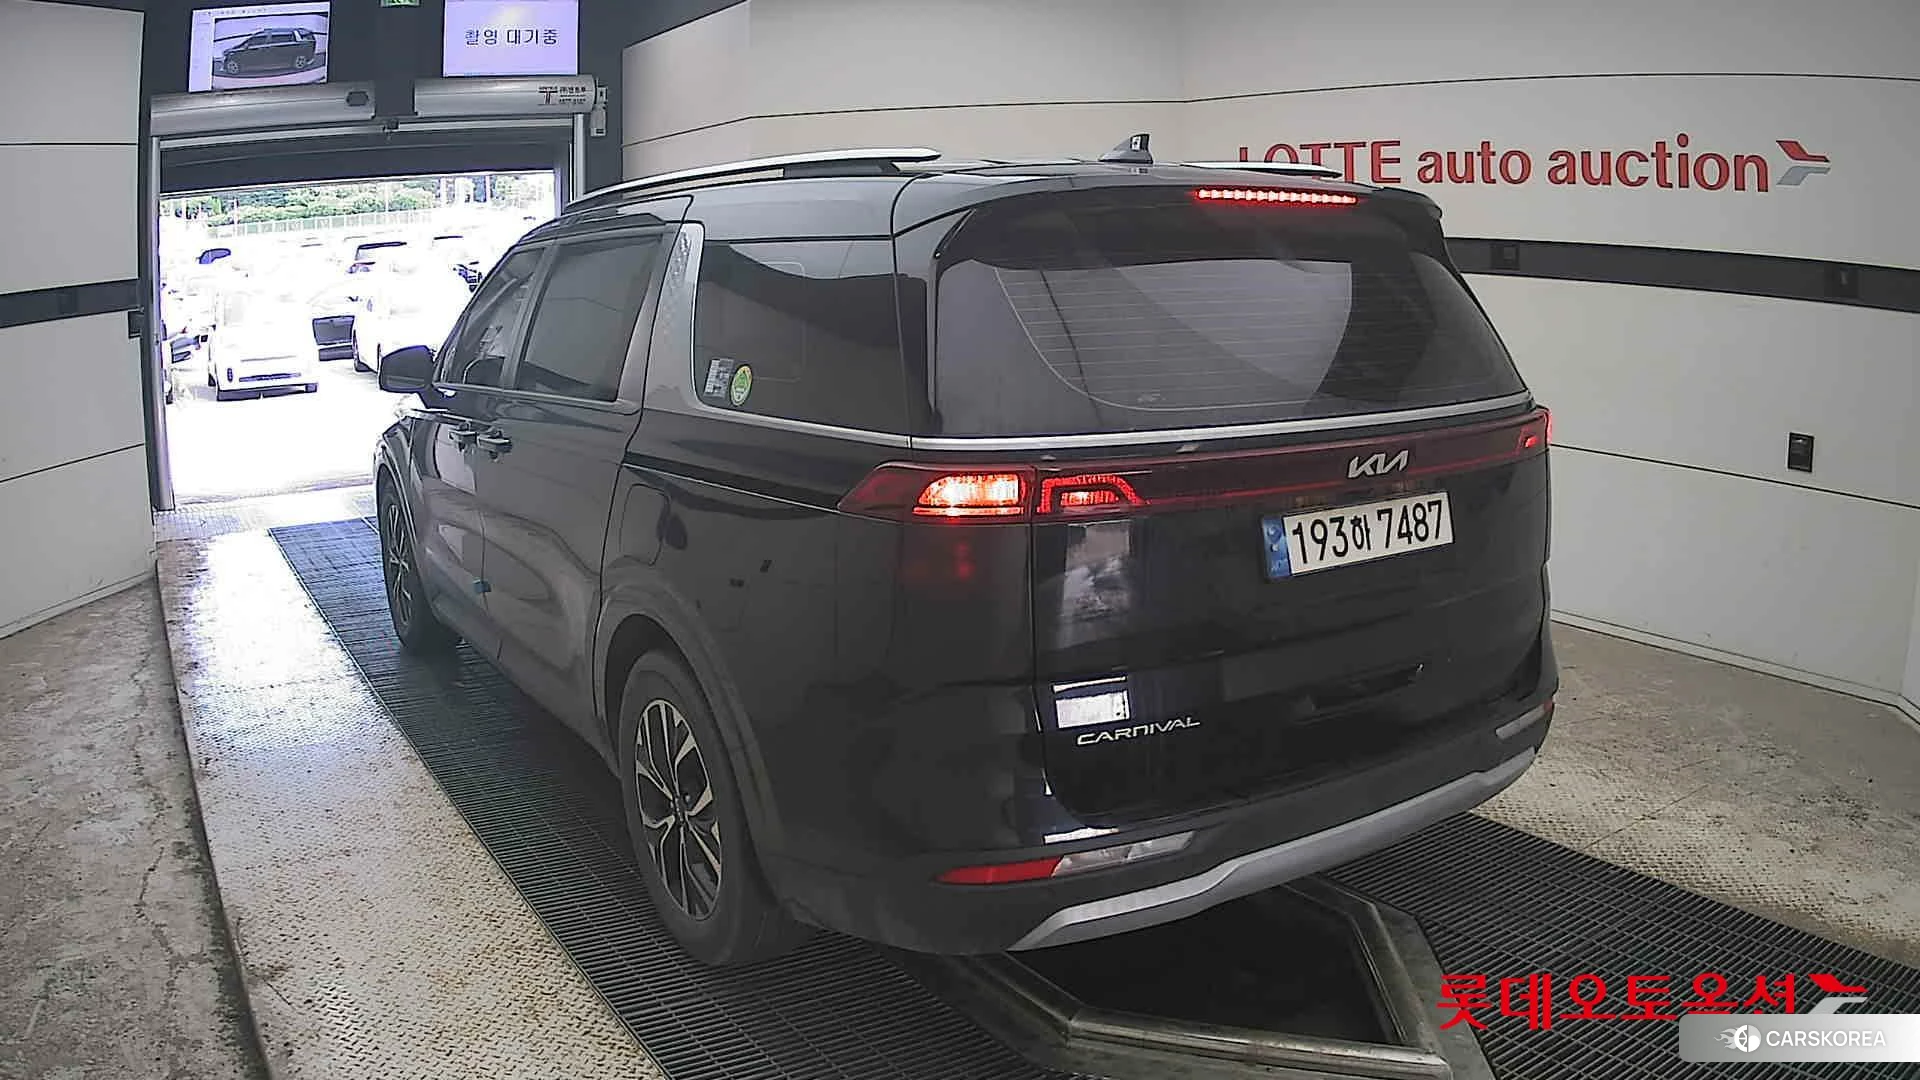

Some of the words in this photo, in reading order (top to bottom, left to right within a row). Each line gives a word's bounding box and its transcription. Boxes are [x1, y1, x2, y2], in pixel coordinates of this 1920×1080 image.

[506, 28, 558, 45] 대기중
[1416, 141, 1532, 185] auto
[1547, 133, 1769, 193] auction
[1347, 449, 1409, 479] KIA
[1292, 513, 1371, 564] 193하
[1377, 500, 1442, 549] 7487
[1077, 716, 1201, 746] CARNIVAL
